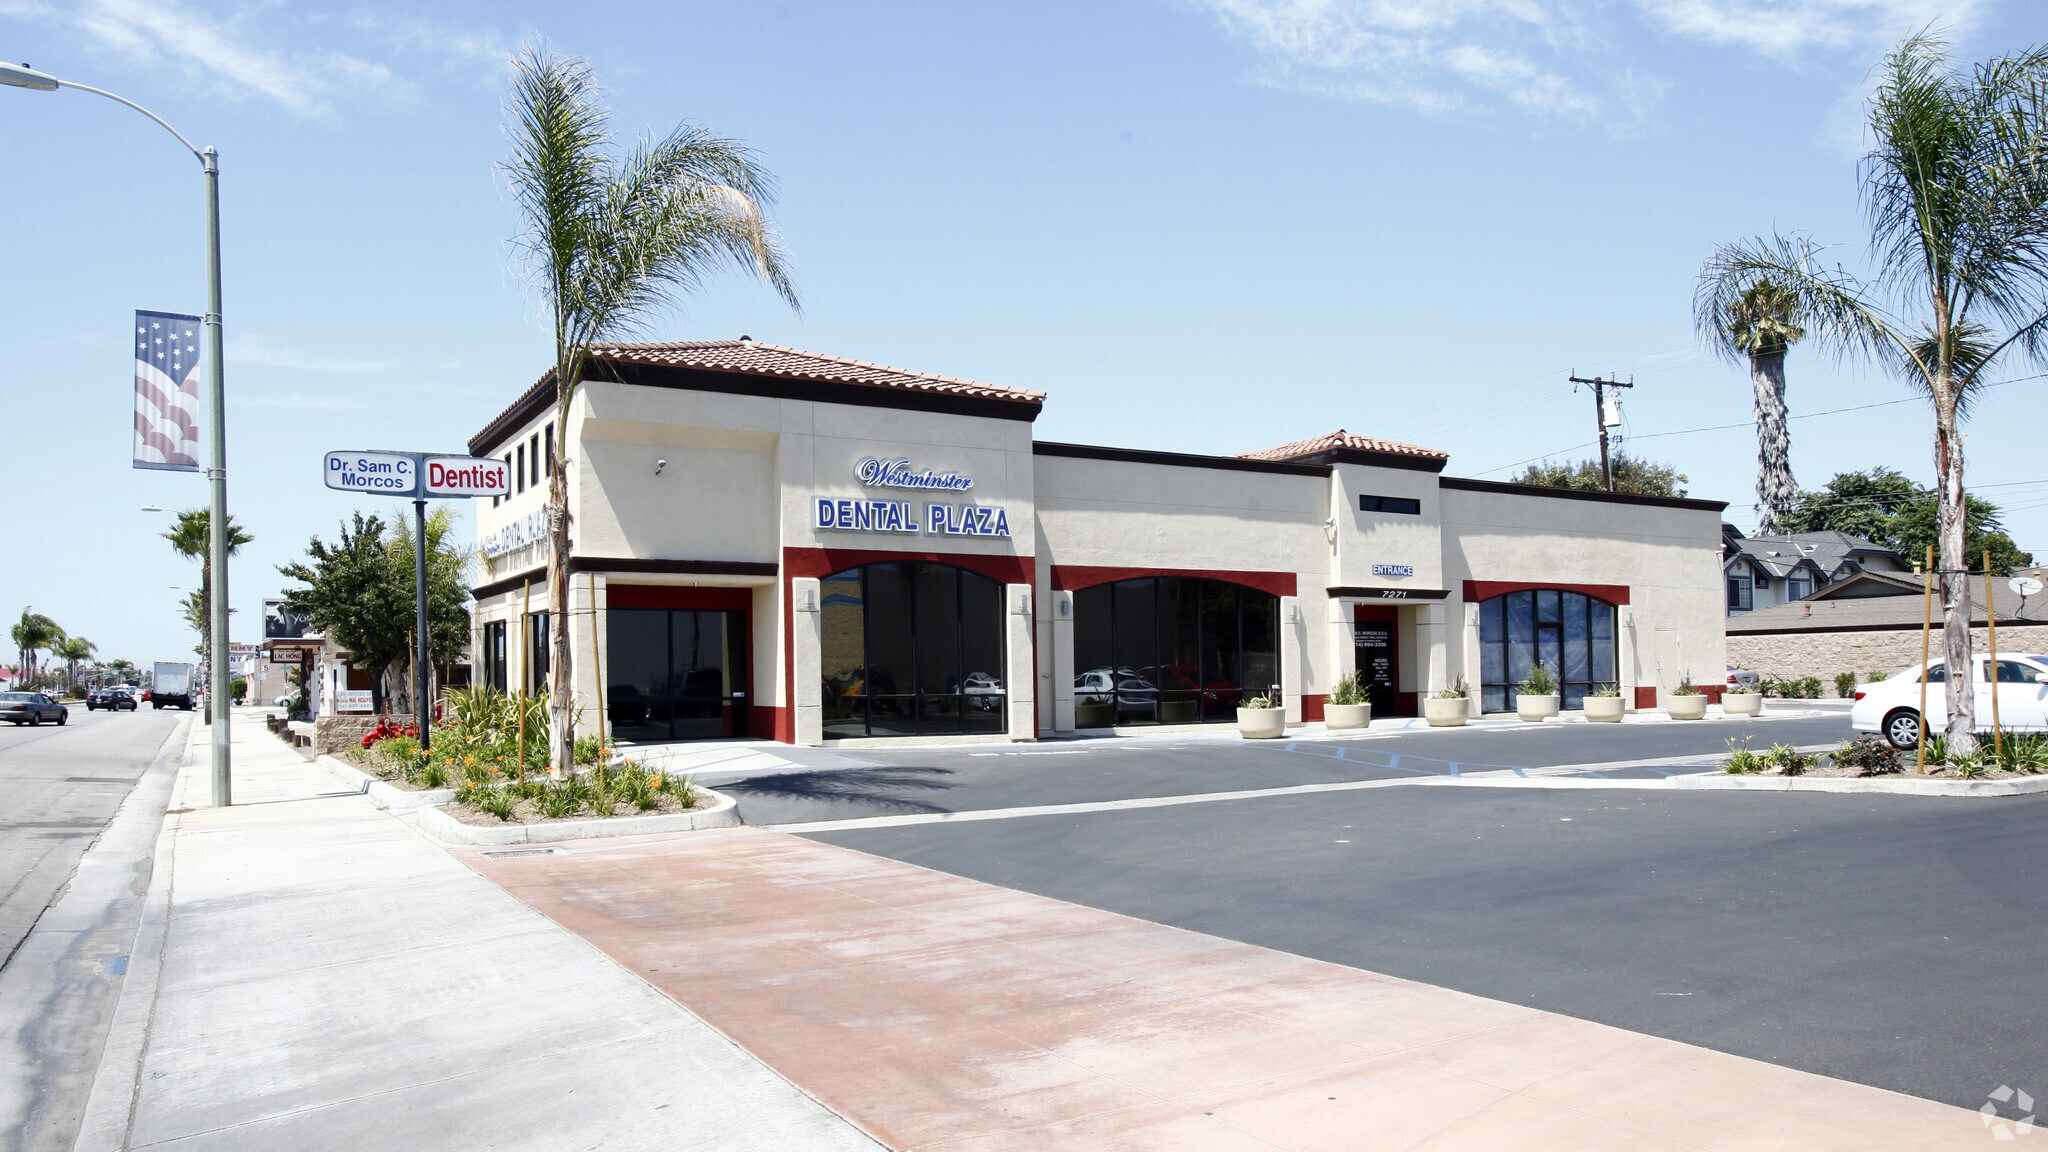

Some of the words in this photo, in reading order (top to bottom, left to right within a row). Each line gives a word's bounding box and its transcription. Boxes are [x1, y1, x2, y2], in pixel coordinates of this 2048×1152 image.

[330, 458, 352, 472] Dr.
[357, 459, 392, 474] Sam
[396, 461, 412, 475] C.
[858, 457, 973, 491] Westminster
[341, 472, 404, 489] Morcos
[429, 463, 505, 489] Dentist
[816, 499, 919, 532] DENTAL
[928, 504, 1012, 536] PLAZA
[1373, 565, 1412, 576] ENTRANCE
[1382, 590, 1407, 599] 7271
